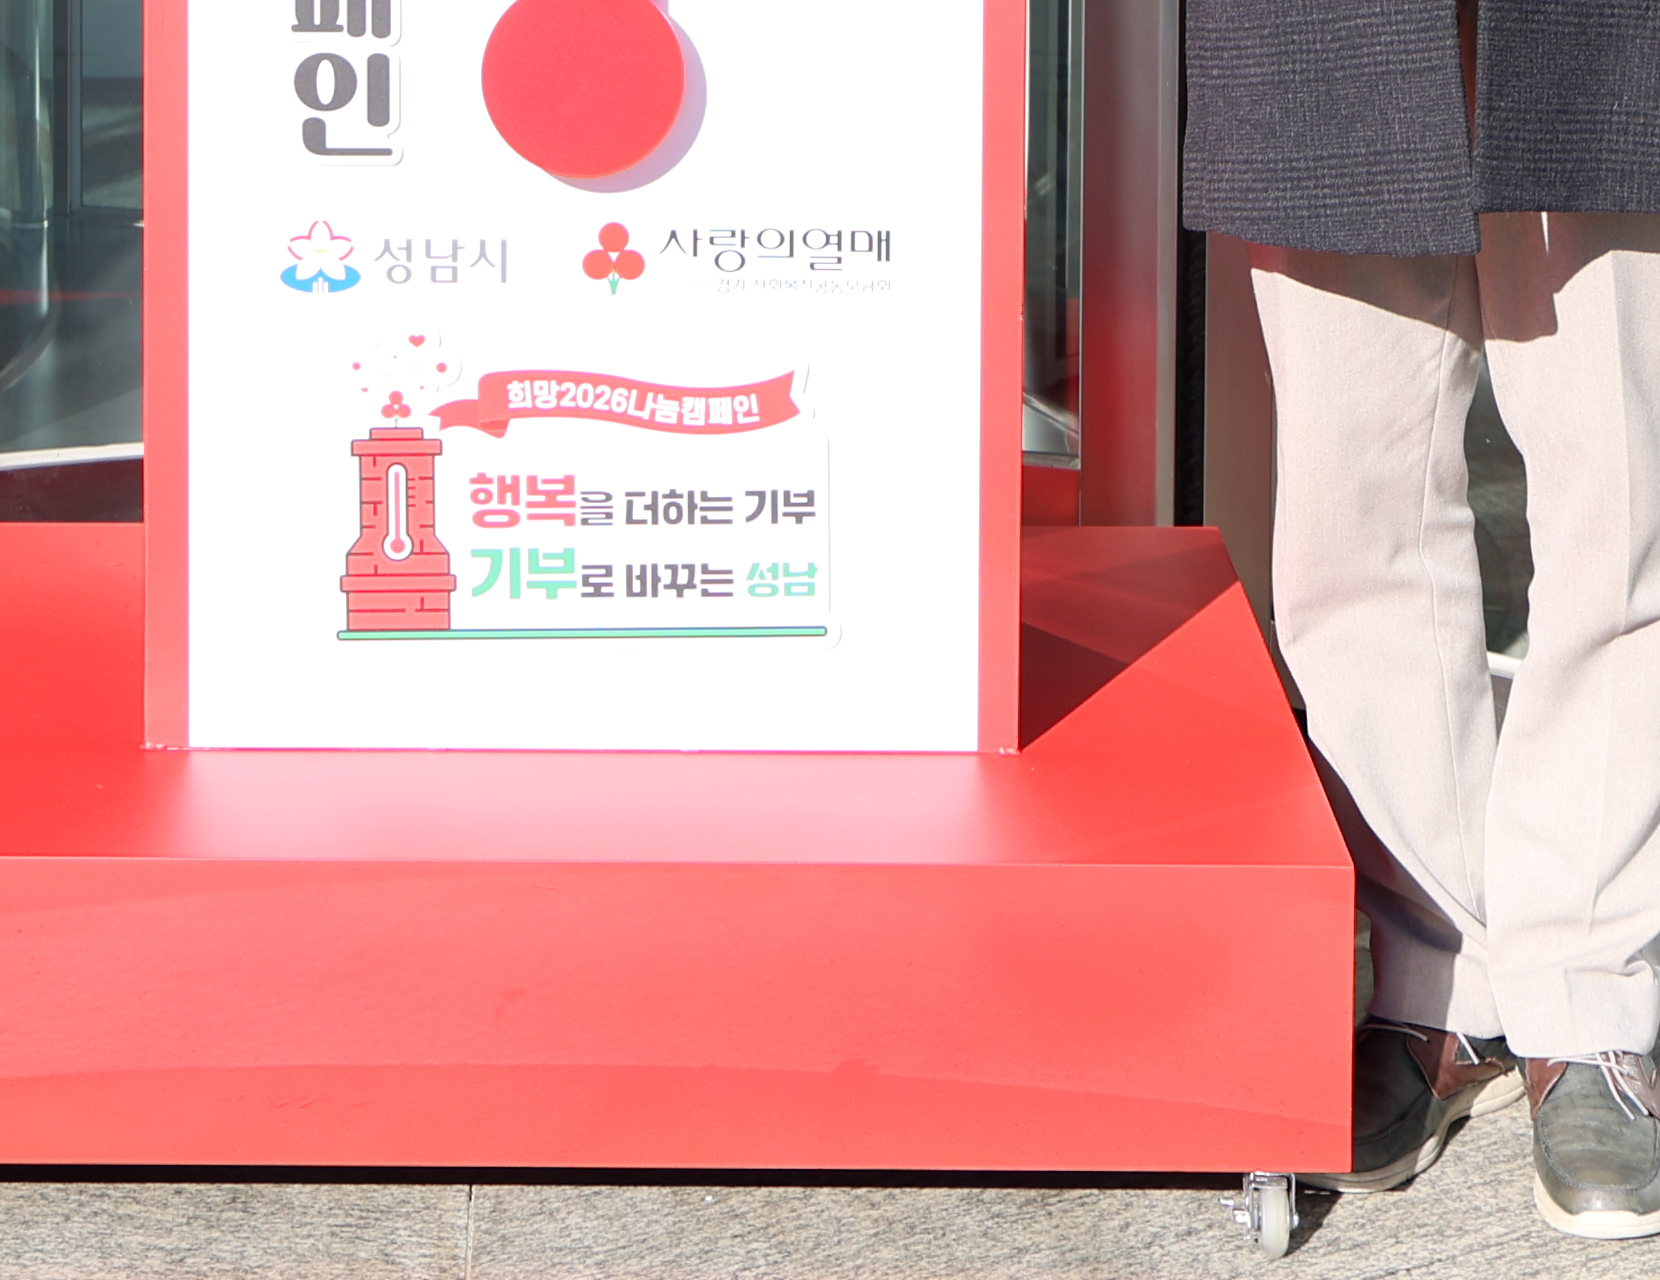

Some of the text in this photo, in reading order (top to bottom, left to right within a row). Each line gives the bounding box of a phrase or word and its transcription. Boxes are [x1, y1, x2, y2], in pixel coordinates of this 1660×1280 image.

[374, 238, 507, 284] 성남시
[659, 228, 891, 273] 사랑의열매
[507, 379, 760, 426] 희망2026나눔캠페인
[469, 472, 816, 528] 행복을 더하는 기부
[470, 547, 818, 600] 기부로 바꾸는 성남
